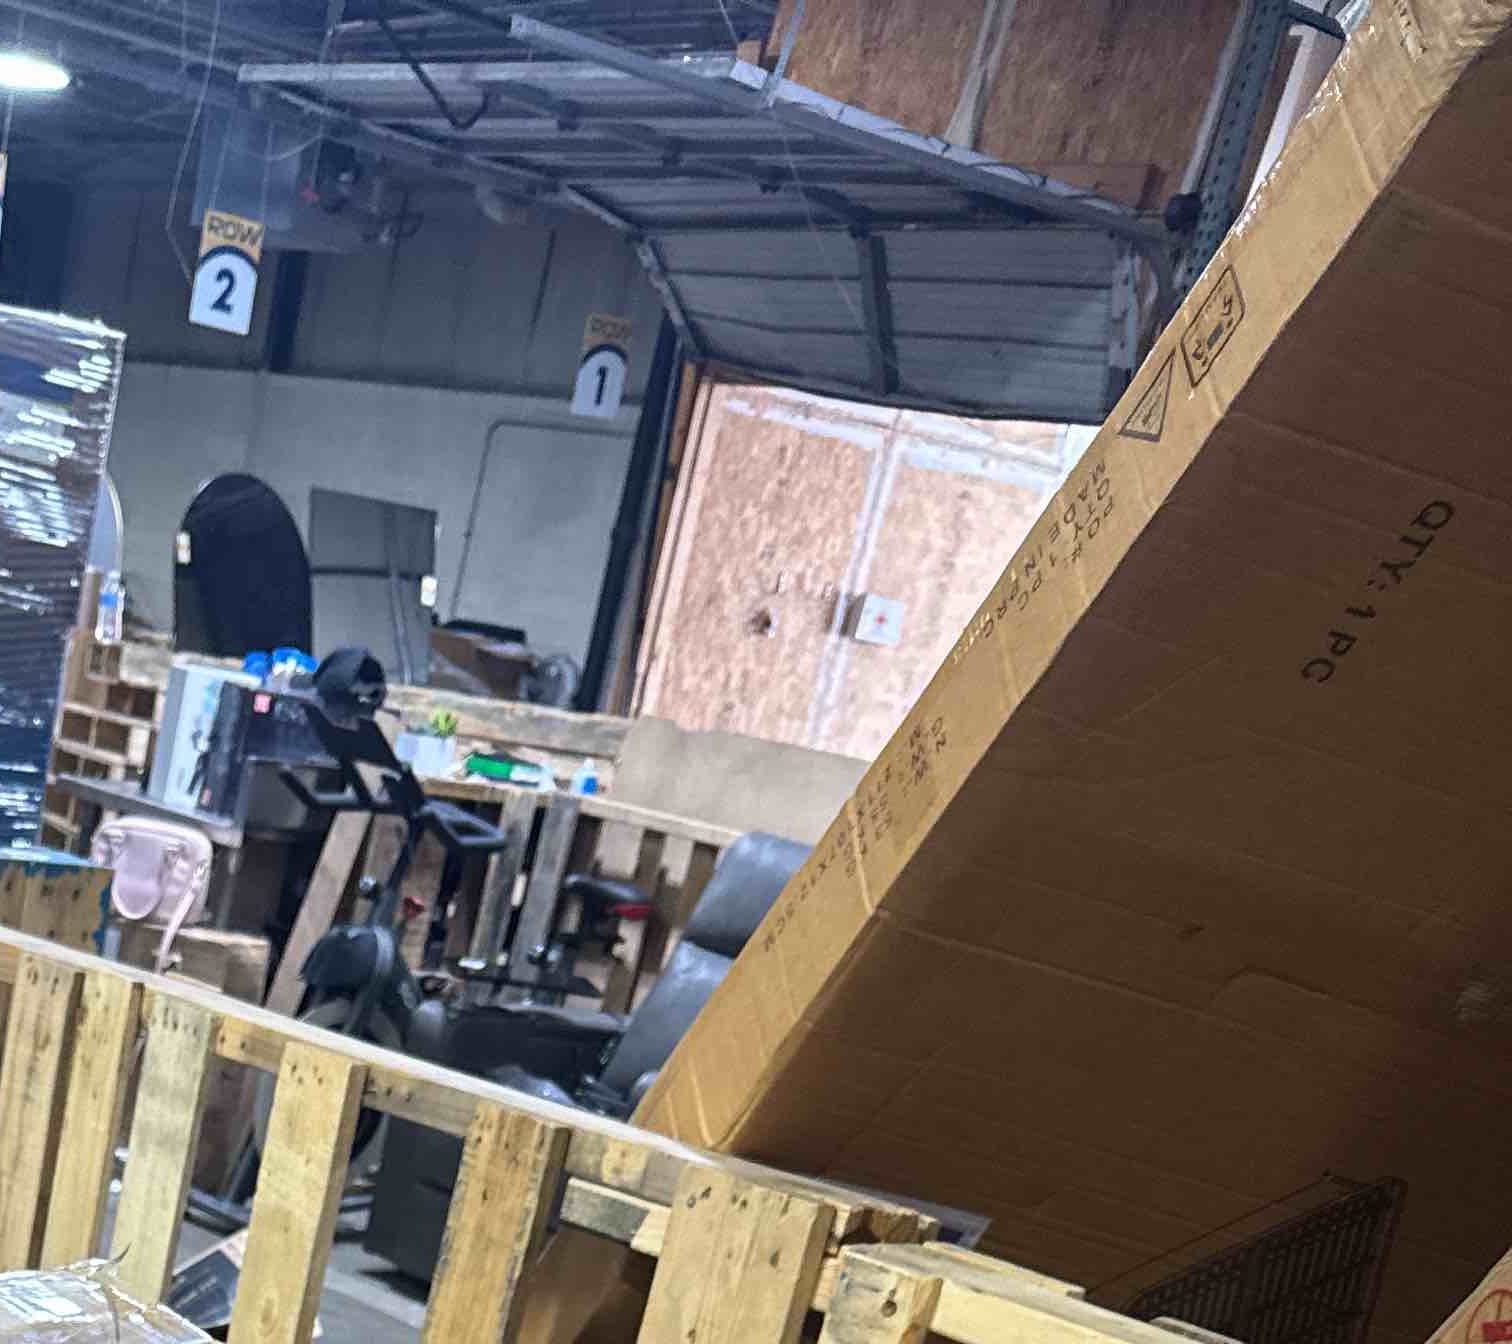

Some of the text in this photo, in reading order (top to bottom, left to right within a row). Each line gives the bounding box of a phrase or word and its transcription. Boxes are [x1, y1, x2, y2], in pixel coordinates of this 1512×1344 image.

[208, 216, 263, 247] ROW
[211, 267, 235, 315] 2
[595, 365, 607, 406] 1
[1047, 457, 1107, 545] MADE
[1300, 500, 1455, 684] QTY: 1 PC
